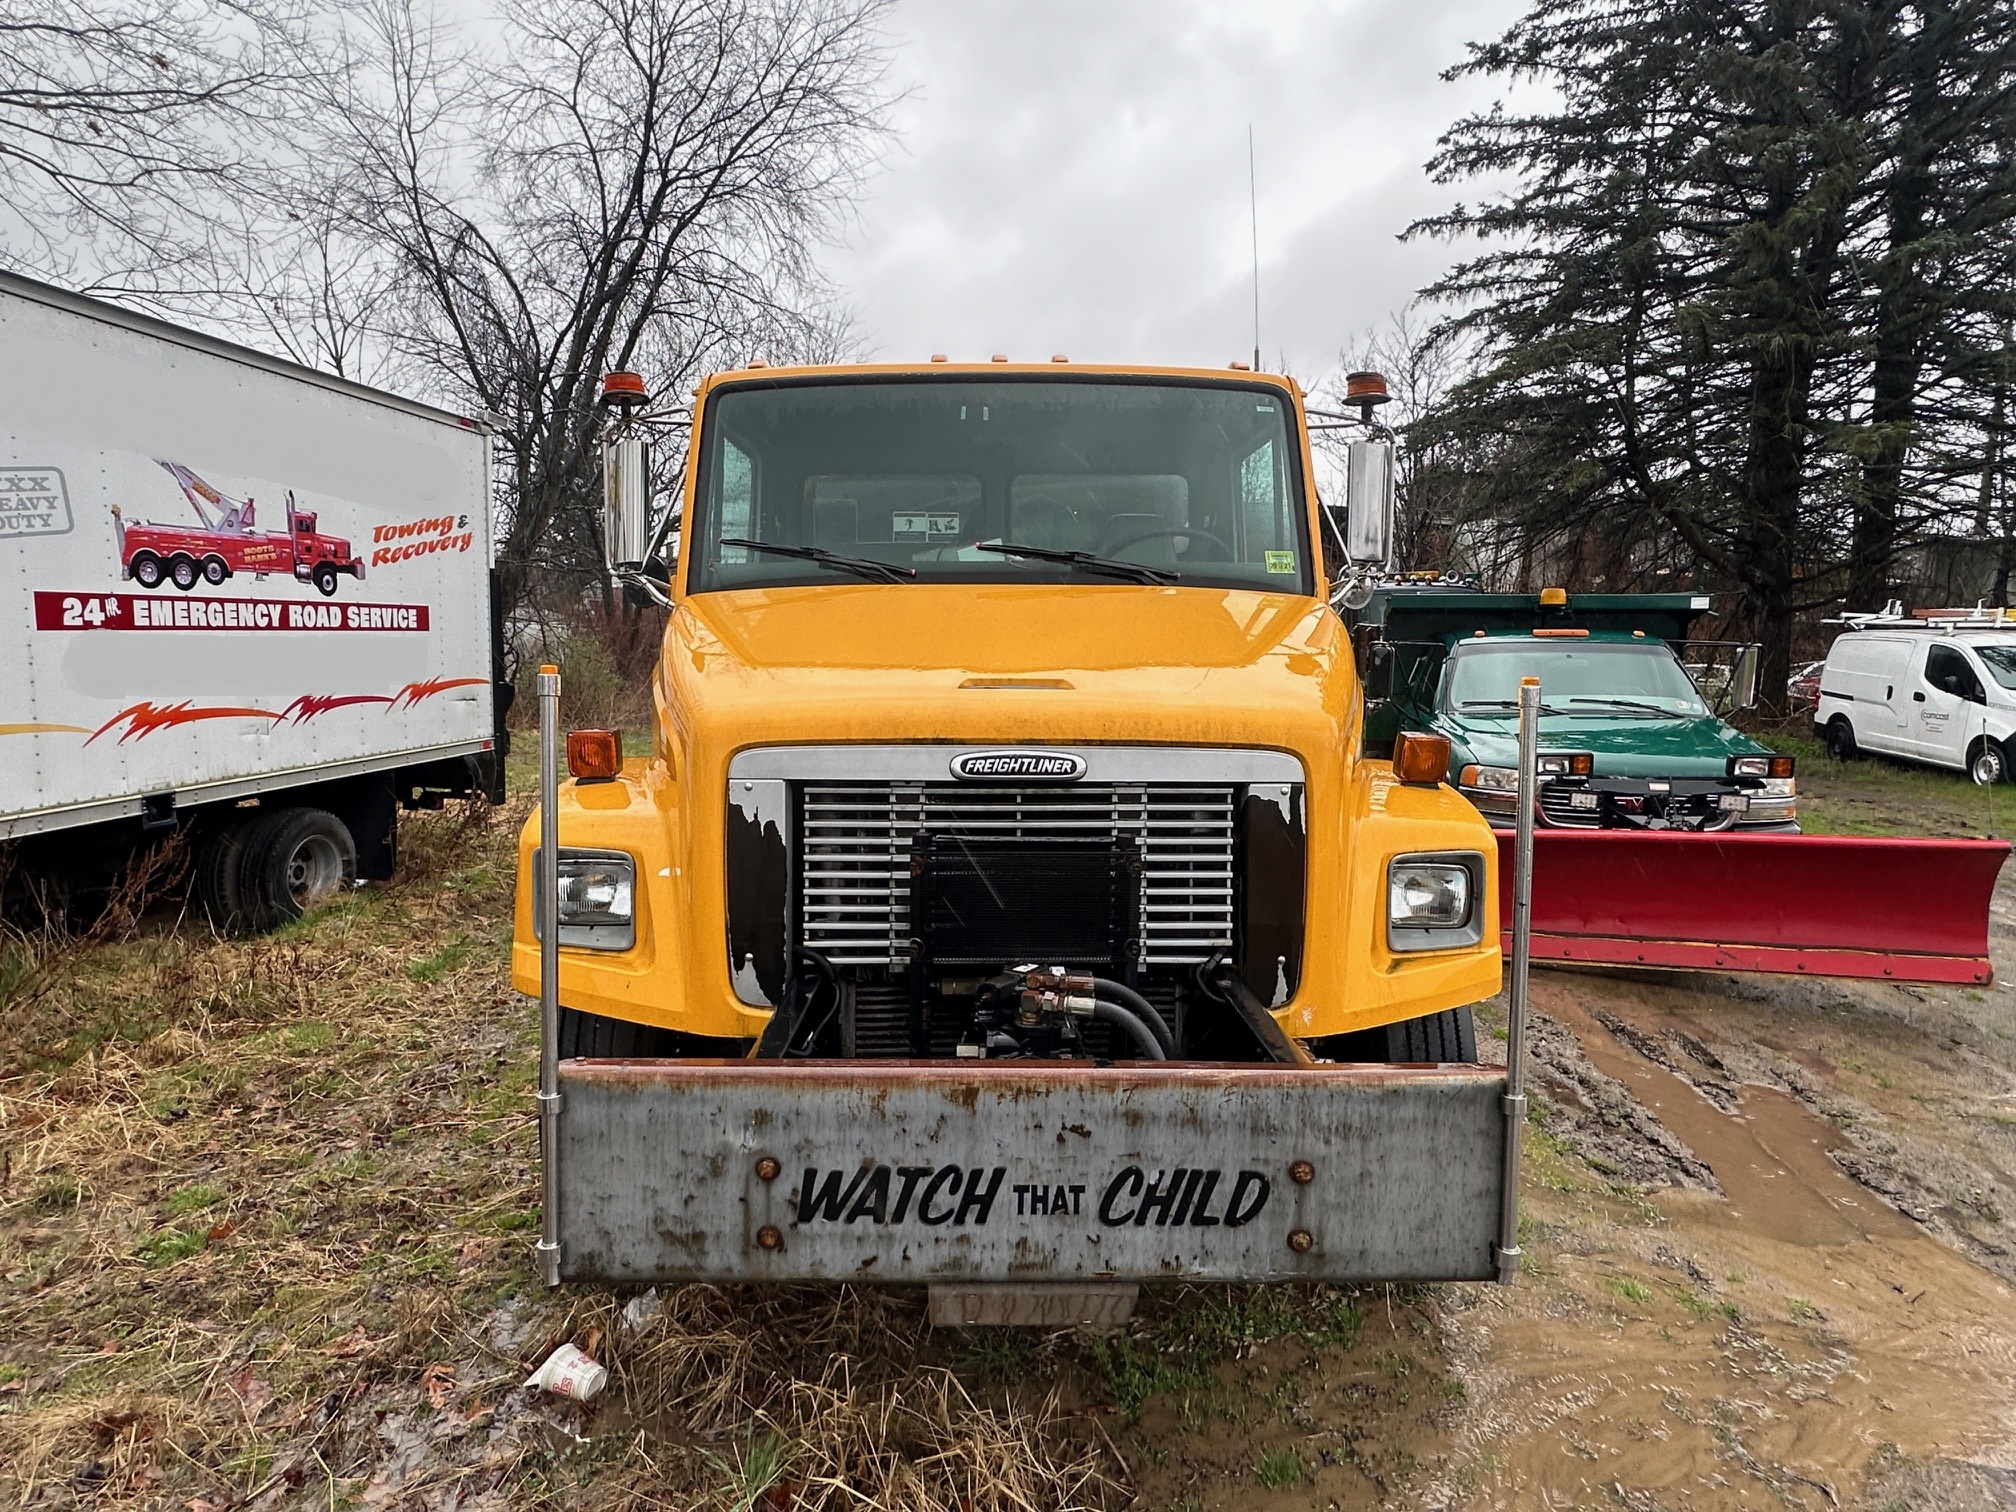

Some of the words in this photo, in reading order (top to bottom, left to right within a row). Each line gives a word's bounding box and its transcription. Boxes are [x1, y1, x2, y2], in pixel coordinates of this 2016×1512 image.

[0, 477, 51, 492] XX
[373, 515, 455, 543] Towing
[457, 514, 469, 529] &
[371, 532, 473, 567] Recovery
[133, 599, 282, 628] EMERGENCY
[288, 604, 342, 628] ROAD
[347, 606, 418, 628] SERVICE
[965, 758, 1072, 773] FREIGHTLINER
[799, 1164, 1007, 1225] WATCH
[1013, 1184, 1086, 1216] THAT
[1099, 1164, 1271, 1227] CHILD
